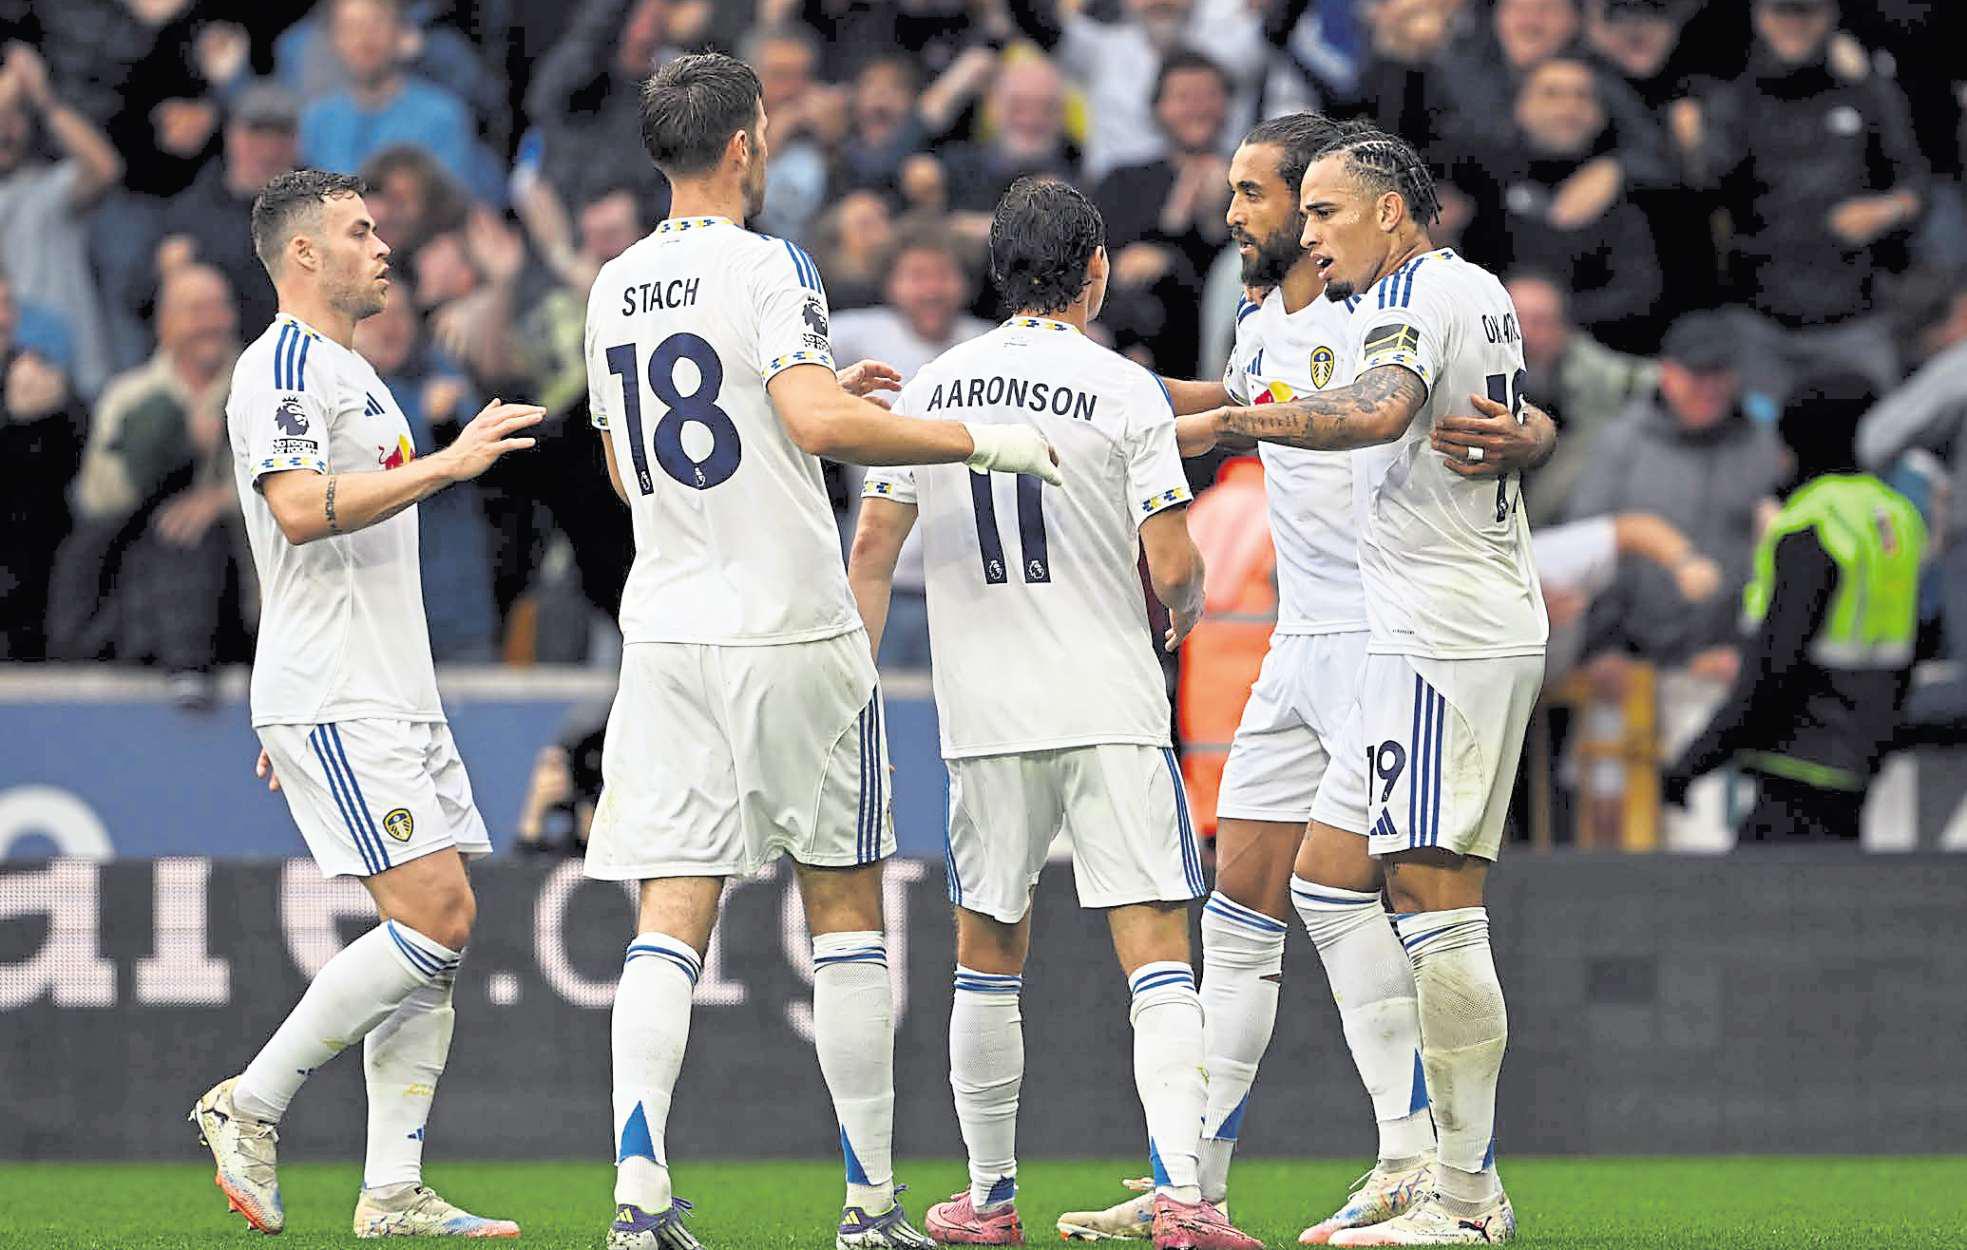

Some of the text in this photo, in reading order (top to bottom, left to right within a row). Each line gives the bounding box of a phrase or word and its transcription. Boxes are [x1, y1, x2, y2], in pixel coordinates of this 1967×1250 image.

[621, 278, 700, 317] STACH
[605, 332, 742, 496] 18
[927, 376, 1098, 421] AARONSON
[969, 469, 1051, 585] 11
[1366, 740, 1406, 806] 19
